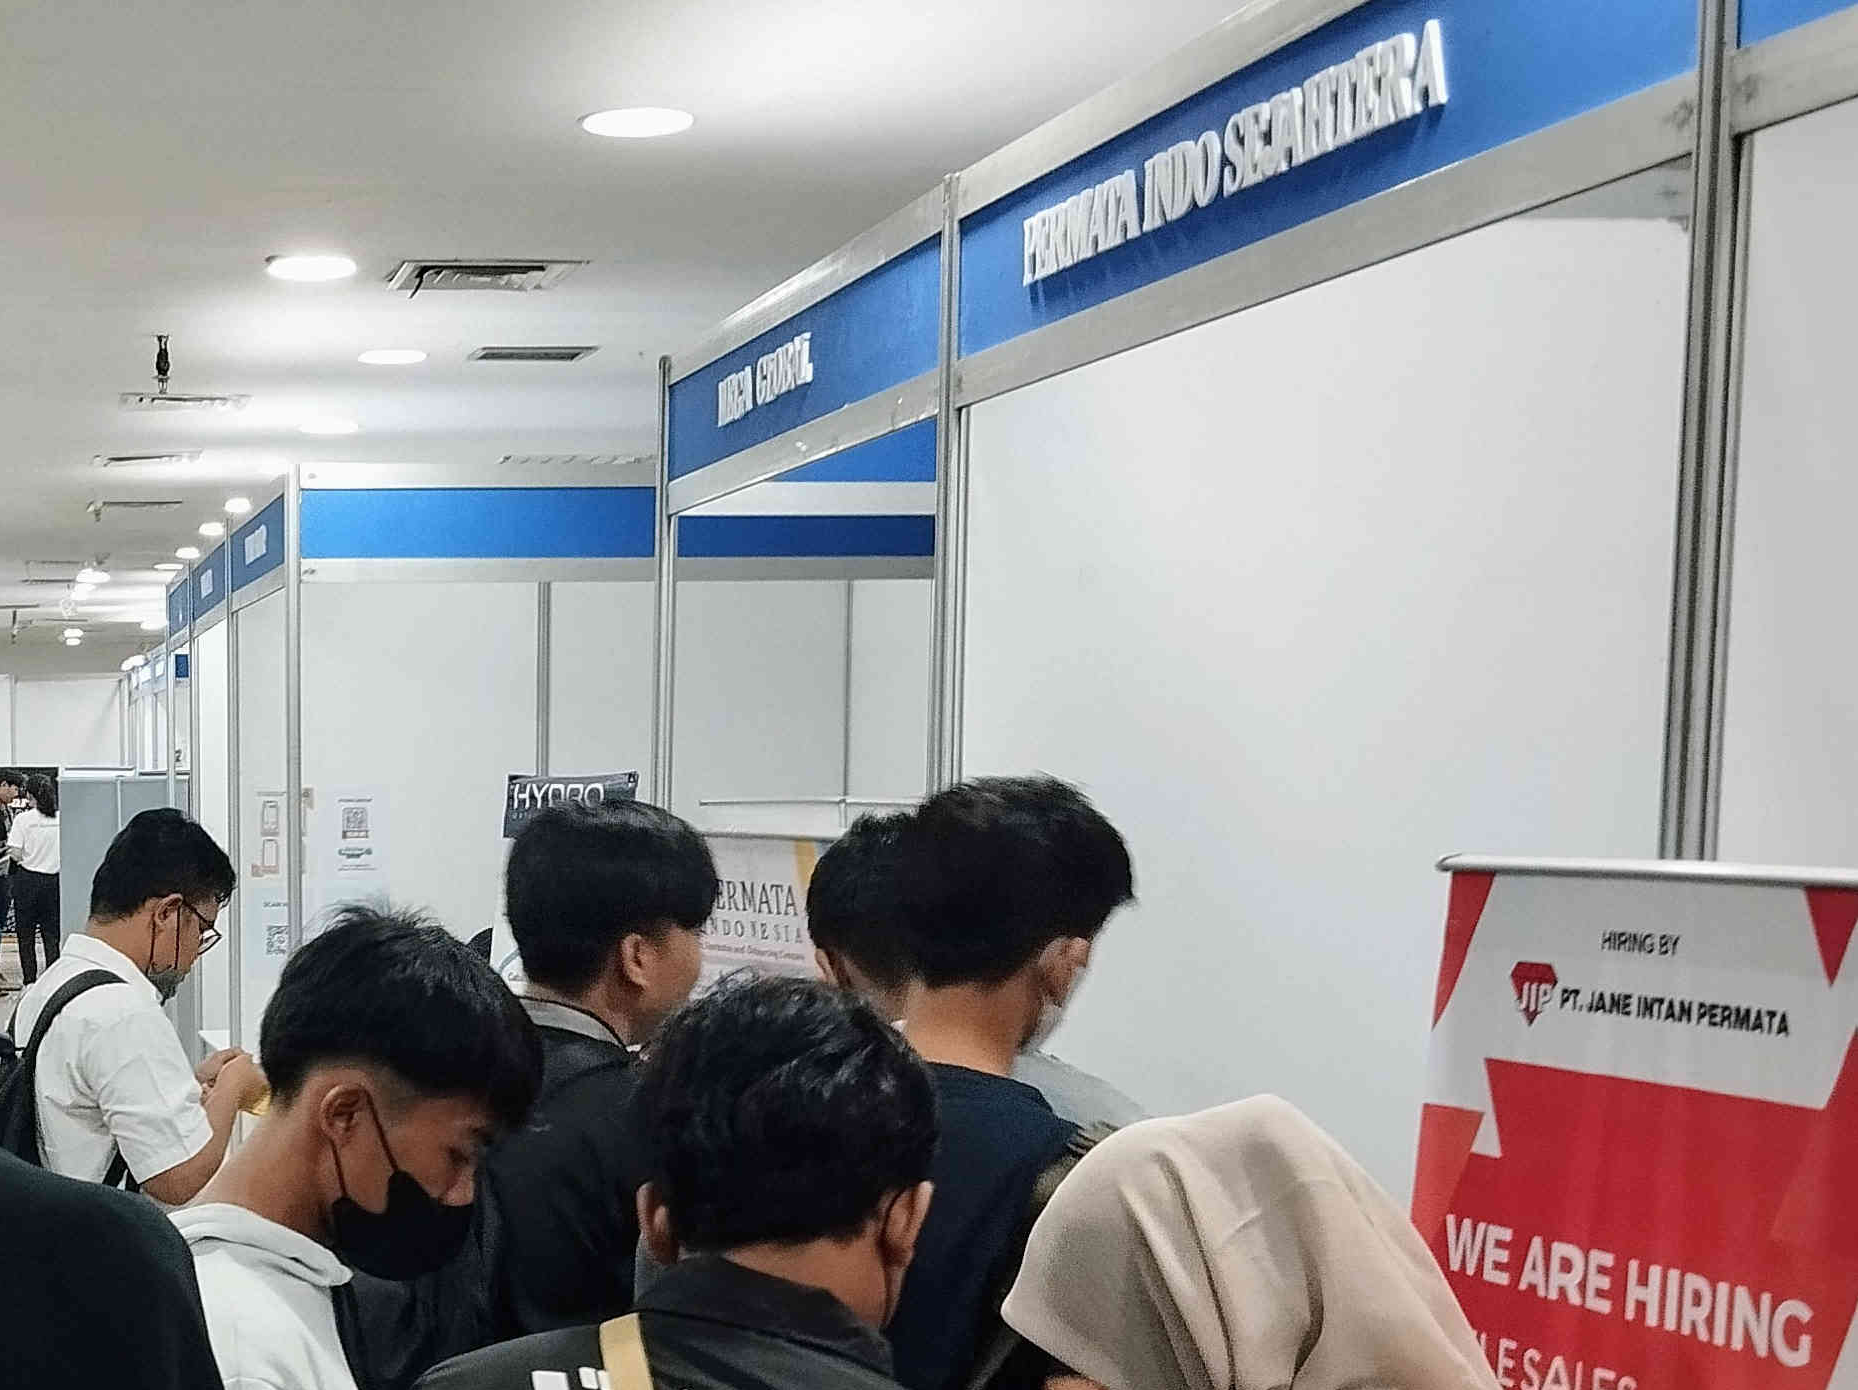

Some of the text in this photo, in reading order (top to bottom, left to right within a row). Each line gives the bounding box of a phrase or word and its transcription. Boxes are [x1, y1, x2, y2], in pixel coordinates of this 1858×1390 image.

[1023, 18, 1448, 287] PERMATA INDO SEJAHTERA
[716, 879, 799, 916] ERMATA
[706, 916, 803, 943] NDONESIA
[1601, 929, 1680, 956] HIRING BY
[1560, 987, 1790, 1037] PT. JANE INTAN PERMATA
[1445, 1213, 1815, 1369] WE ARE HIRING
